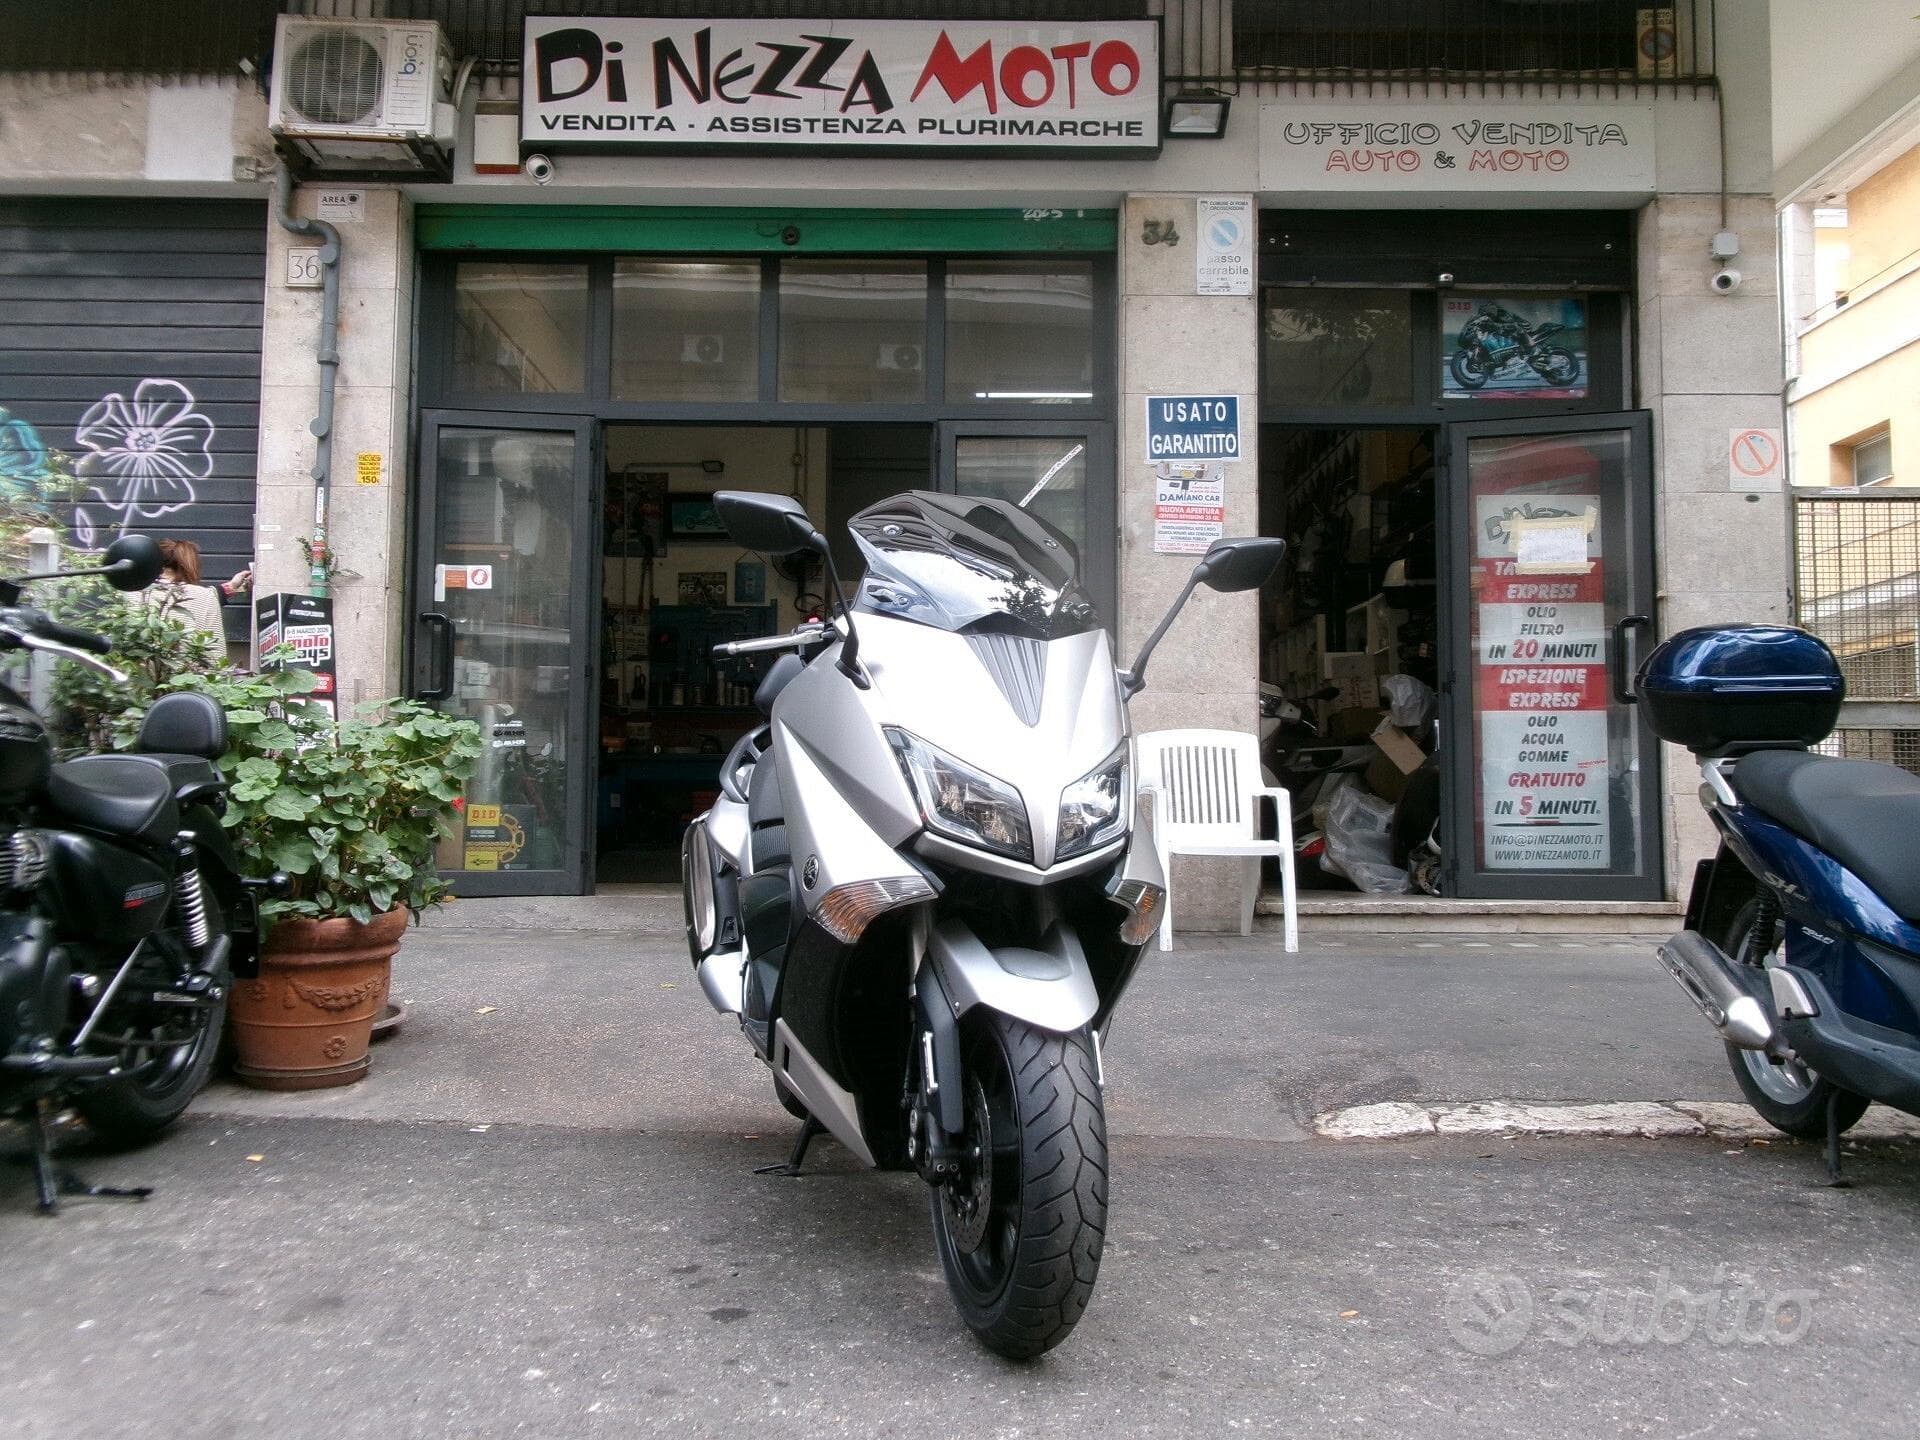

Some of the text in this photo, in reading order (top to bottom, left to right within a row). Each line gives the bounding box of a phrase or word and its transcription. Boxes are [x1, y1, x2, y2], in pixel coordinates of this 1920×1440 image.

[534, 26, 1140, 114] Di NEZZA MOTO
[540, 114, 676, 132] VENDITA
[706, 115, 906, 134] ASSISTENZA
[918, 118, 1143, 137] PLURIMARCHE
[1283, 119, 1628, 146] UFFICIO VENDITA
[1325, 150, 1569, 172] AUTO & MOTO
[1141, 218, 1180, 246] 34
[289, 255, 320, 279] 36
[1207, 255, 1241, 265] passo
[1199, 265, 1249, 275] carrabile
[1163, 401, 1226, 422] USATO
[1151, 433, 1237, 454] GARANTITO
[1159, 493, 1203, 502] DAMIANO
[1507, 584, 1578, 599] EXPRESS
[1527, 607, 1557, 618] OLIO
[1520, 624, 1564, 635] FILTRO
[1488, 639, 1598, 658] IN 20 MINUTI
[1500, 668, 1587, 684] ISPEZIONE
[1509, 692, 1580, 708] EXPRESS
[1528, 716, 1558, 727] OLIO
[1521, 733, 1564, 746] ACQUA
[1518, 751, 1569, 762] GOMME
[1508, 772, 1586, 788] GRATUITO
[1494, 800, 1513, 814] IN
[1519, 795, 1533, 816] 5
[1491, 834, 1604, 847] INFO@DINEZZAMOTO.IT
[1495, 849, 1601, 861] WWW.DINEZZAMOTO.IT
[1764, 871, 1798, 894] SH
